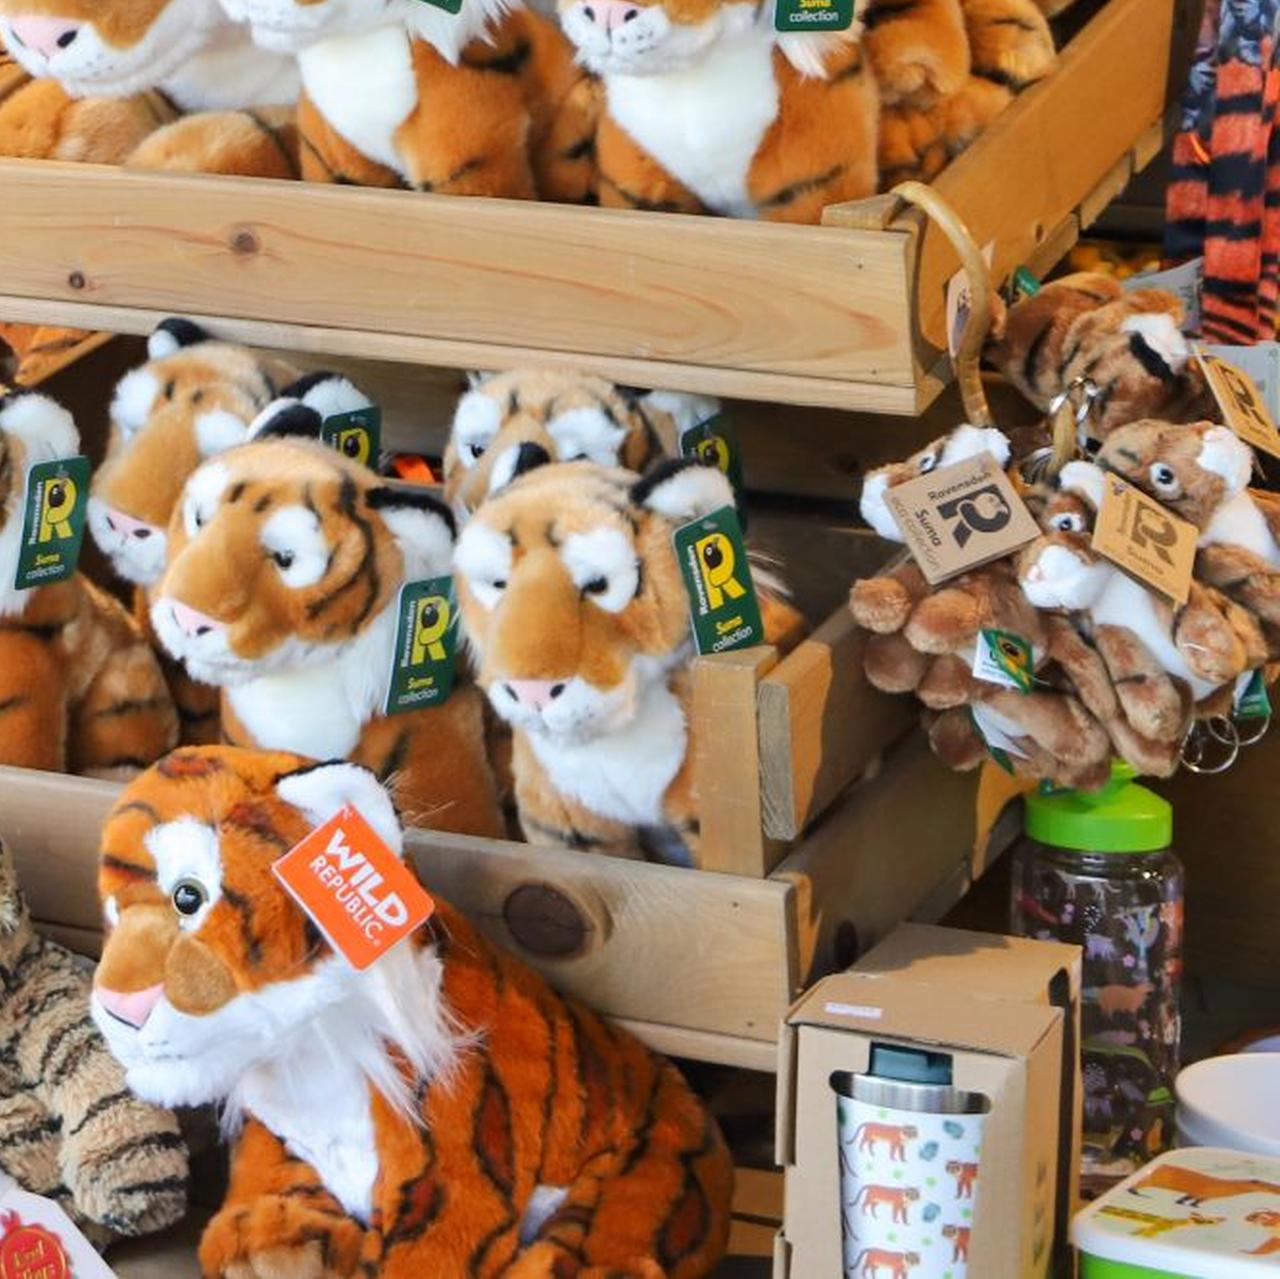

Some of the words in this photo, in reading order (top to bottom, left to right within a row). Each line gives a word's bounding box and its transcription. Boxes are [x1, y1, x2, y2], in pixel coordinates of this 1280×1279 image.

[789, 9, 839, 22] collection
[927, 471, 992, 503] Ravensden
[914, 507, 942, 547] Suma
[712, 625, 753, 652] collection
[715, 615, 743, 635] Suma
[398, 687, 439, 704] collection
[325, 828, 408, 927] WILD
[309, 855, 384, 940] REPUBLIC
